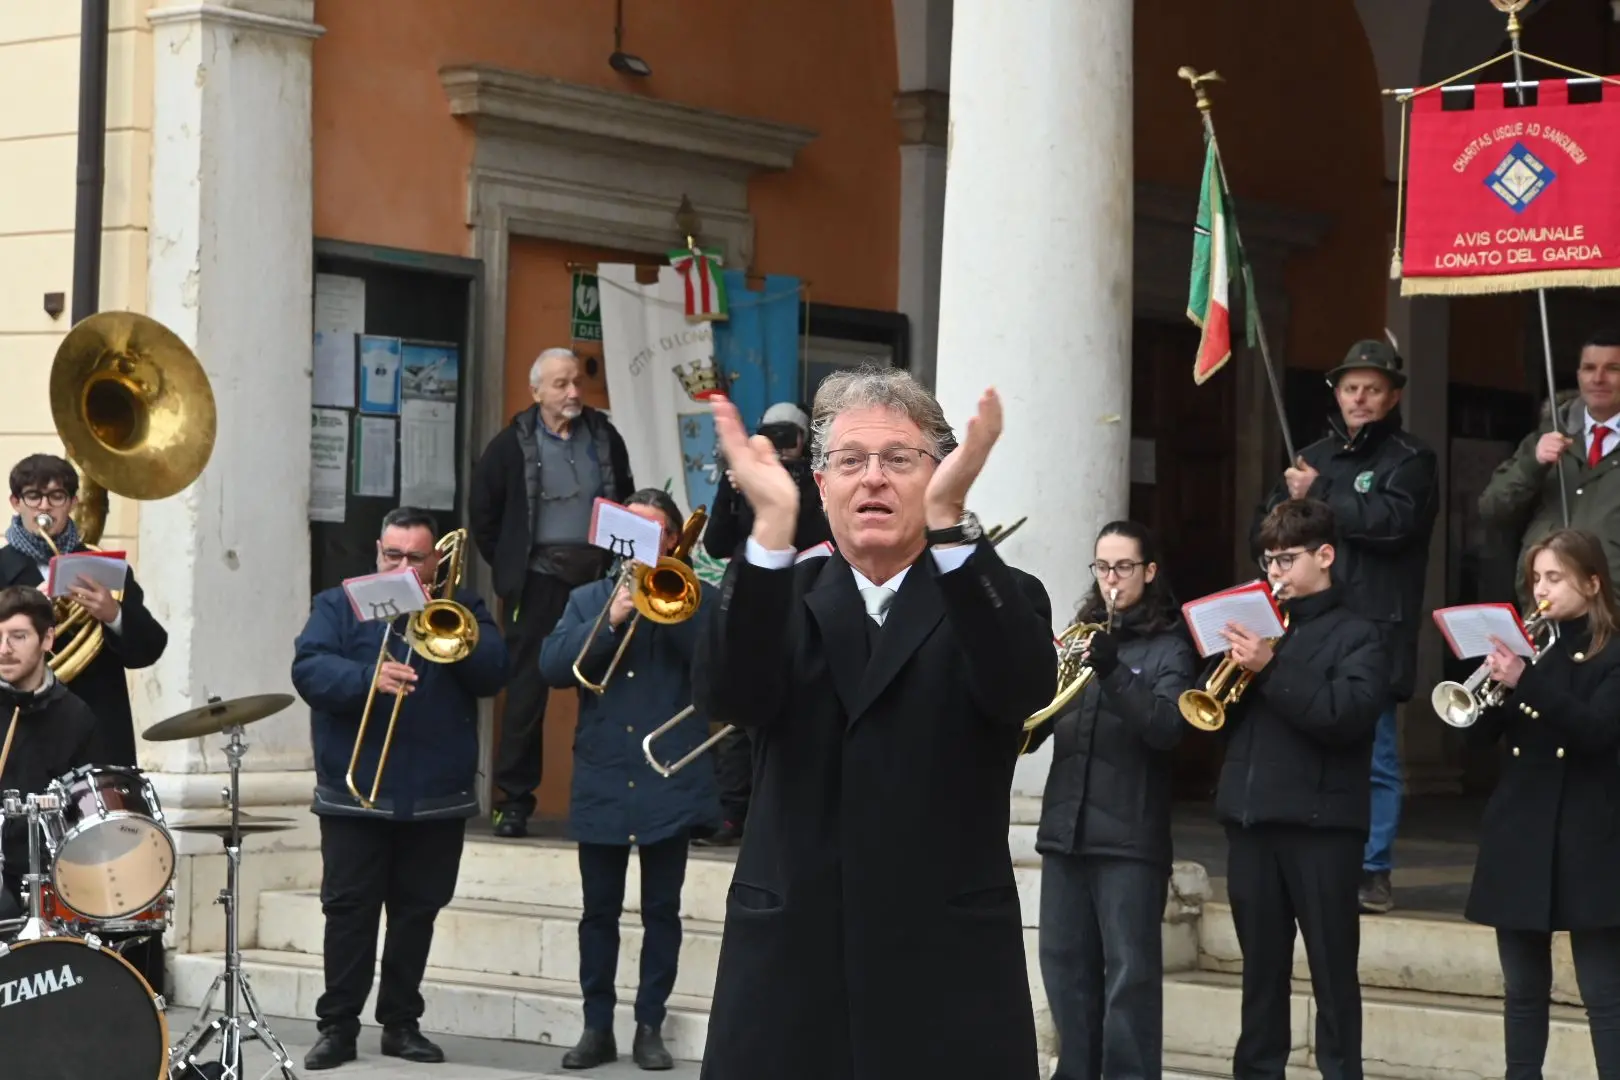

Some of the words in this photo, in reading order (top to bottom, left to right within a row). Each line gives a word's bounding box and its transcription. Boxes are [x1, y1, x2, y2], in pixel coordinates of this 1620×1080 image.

[1452, 132, 1493, 174] CHARITAS
[1492, 121, 1524, 142] USQUE
[1525, 123, 1540, 137] AD
[1453, 231, 1491, 247] AVIS
[1495, 224, 1585, 244] COMUNALE
[1434, 250, 1502, 269] LONATO
[1507, 247, 1537, 264] DEL
[1542, 244, 1603, 262] GARDA
[579, 324, 601, 338] DAE
